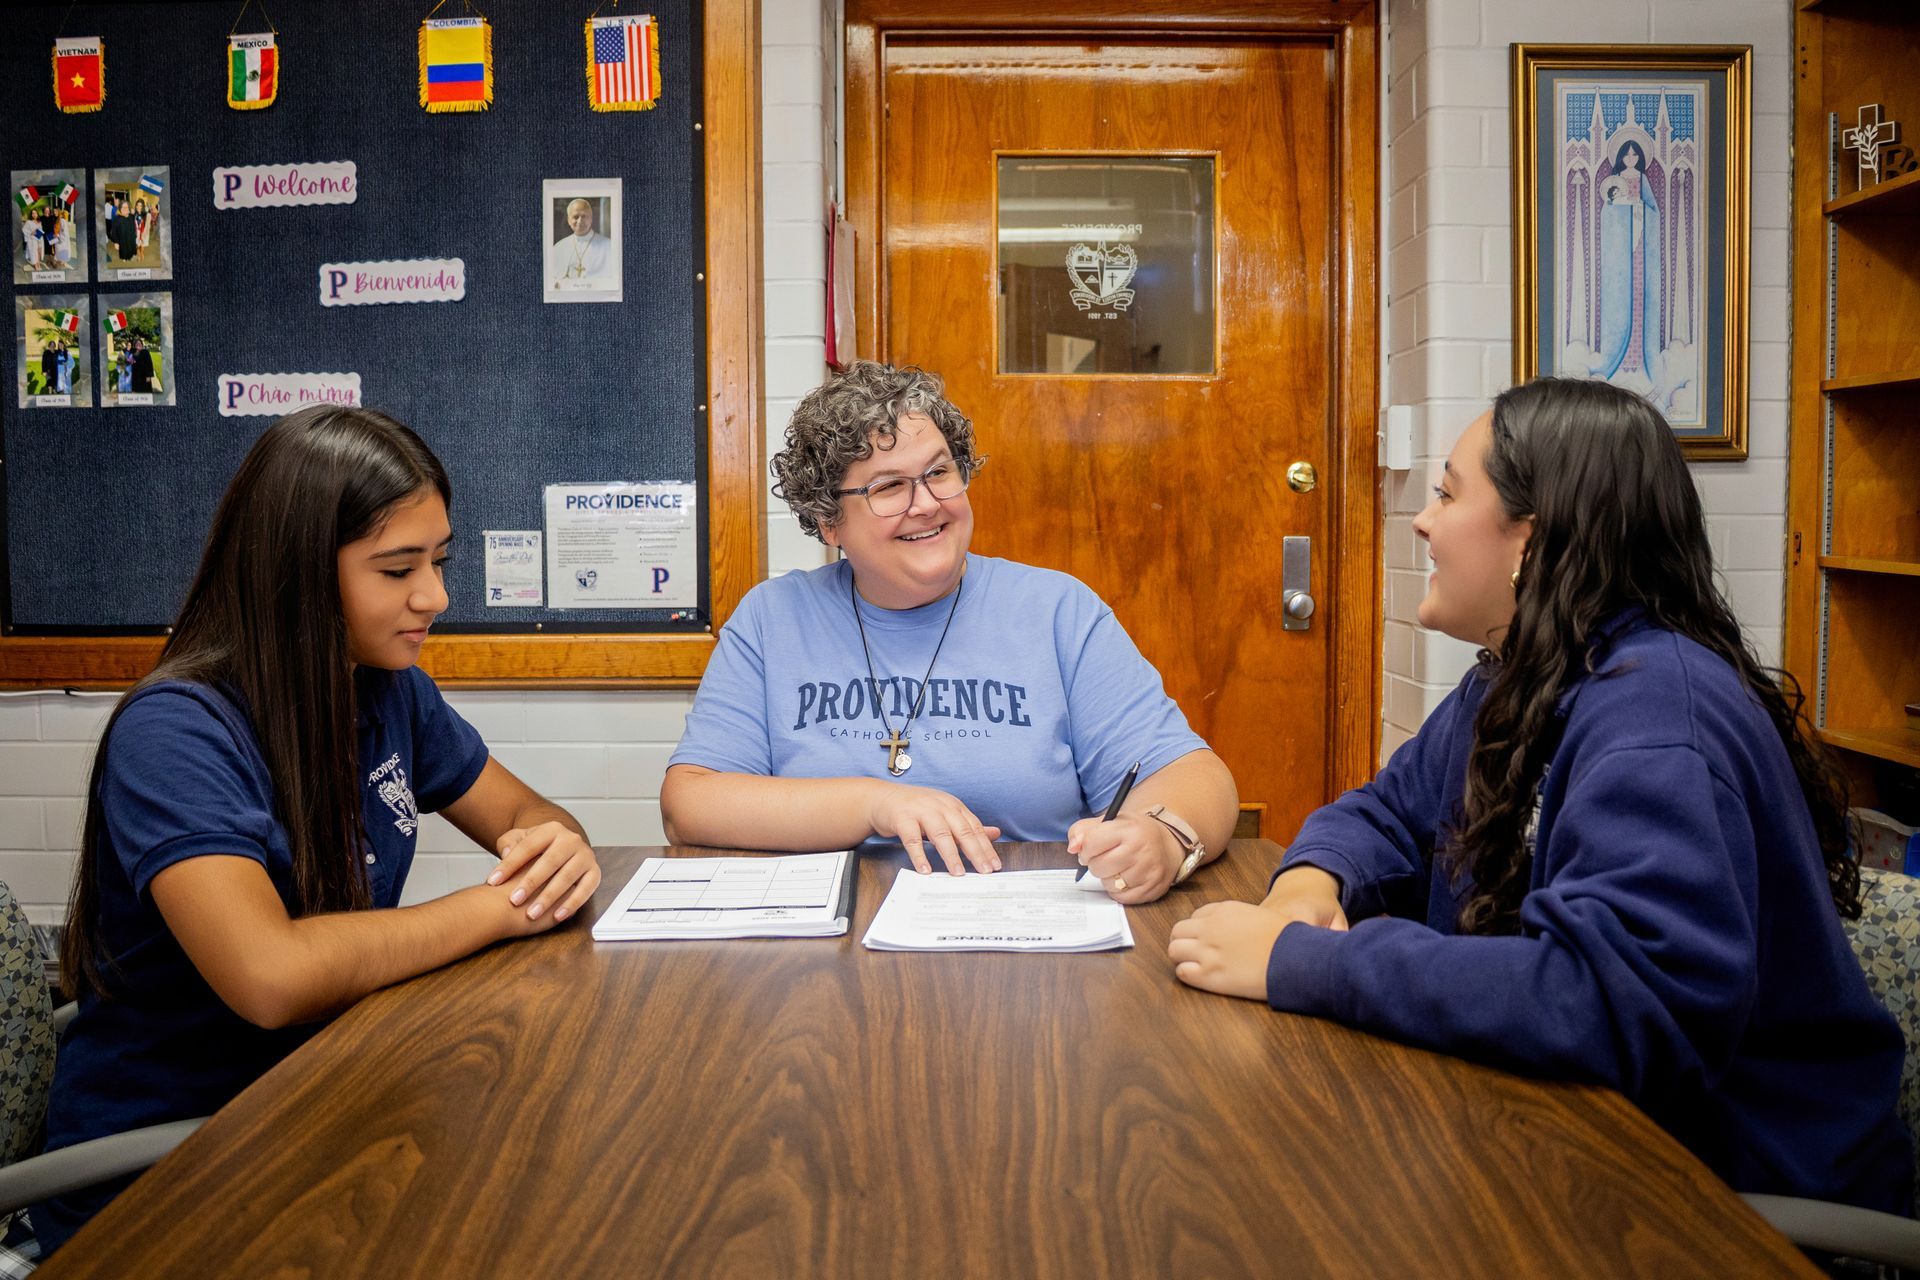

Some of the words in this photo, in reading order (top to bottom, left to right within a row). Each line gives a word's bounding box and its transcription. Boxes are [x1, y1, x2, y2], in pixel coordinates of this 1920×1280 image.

[433, 19, 478, 27] COLOMBIA
[58, 48, 98, 56] VIETNAM
[237, 40, 268, 49] MEXICO
[223, 174, 242, 202] P
[254, 169, 354, 198] Welcome
[328, 270, 348, 299] P
[354, 269, 459, 294] Bienvenida
[226, 381, 245, 409] P
[566, 493, 682, 510] PROVIDENCE
[652, 567, 670, 593] P
[490, 587, 502, 600] 75
[793, 675, 1032, 731] PROVIDENCE
[830, 727, 912, 740] CATHOLC
[924, 729, 992, 742] SCHOOL
